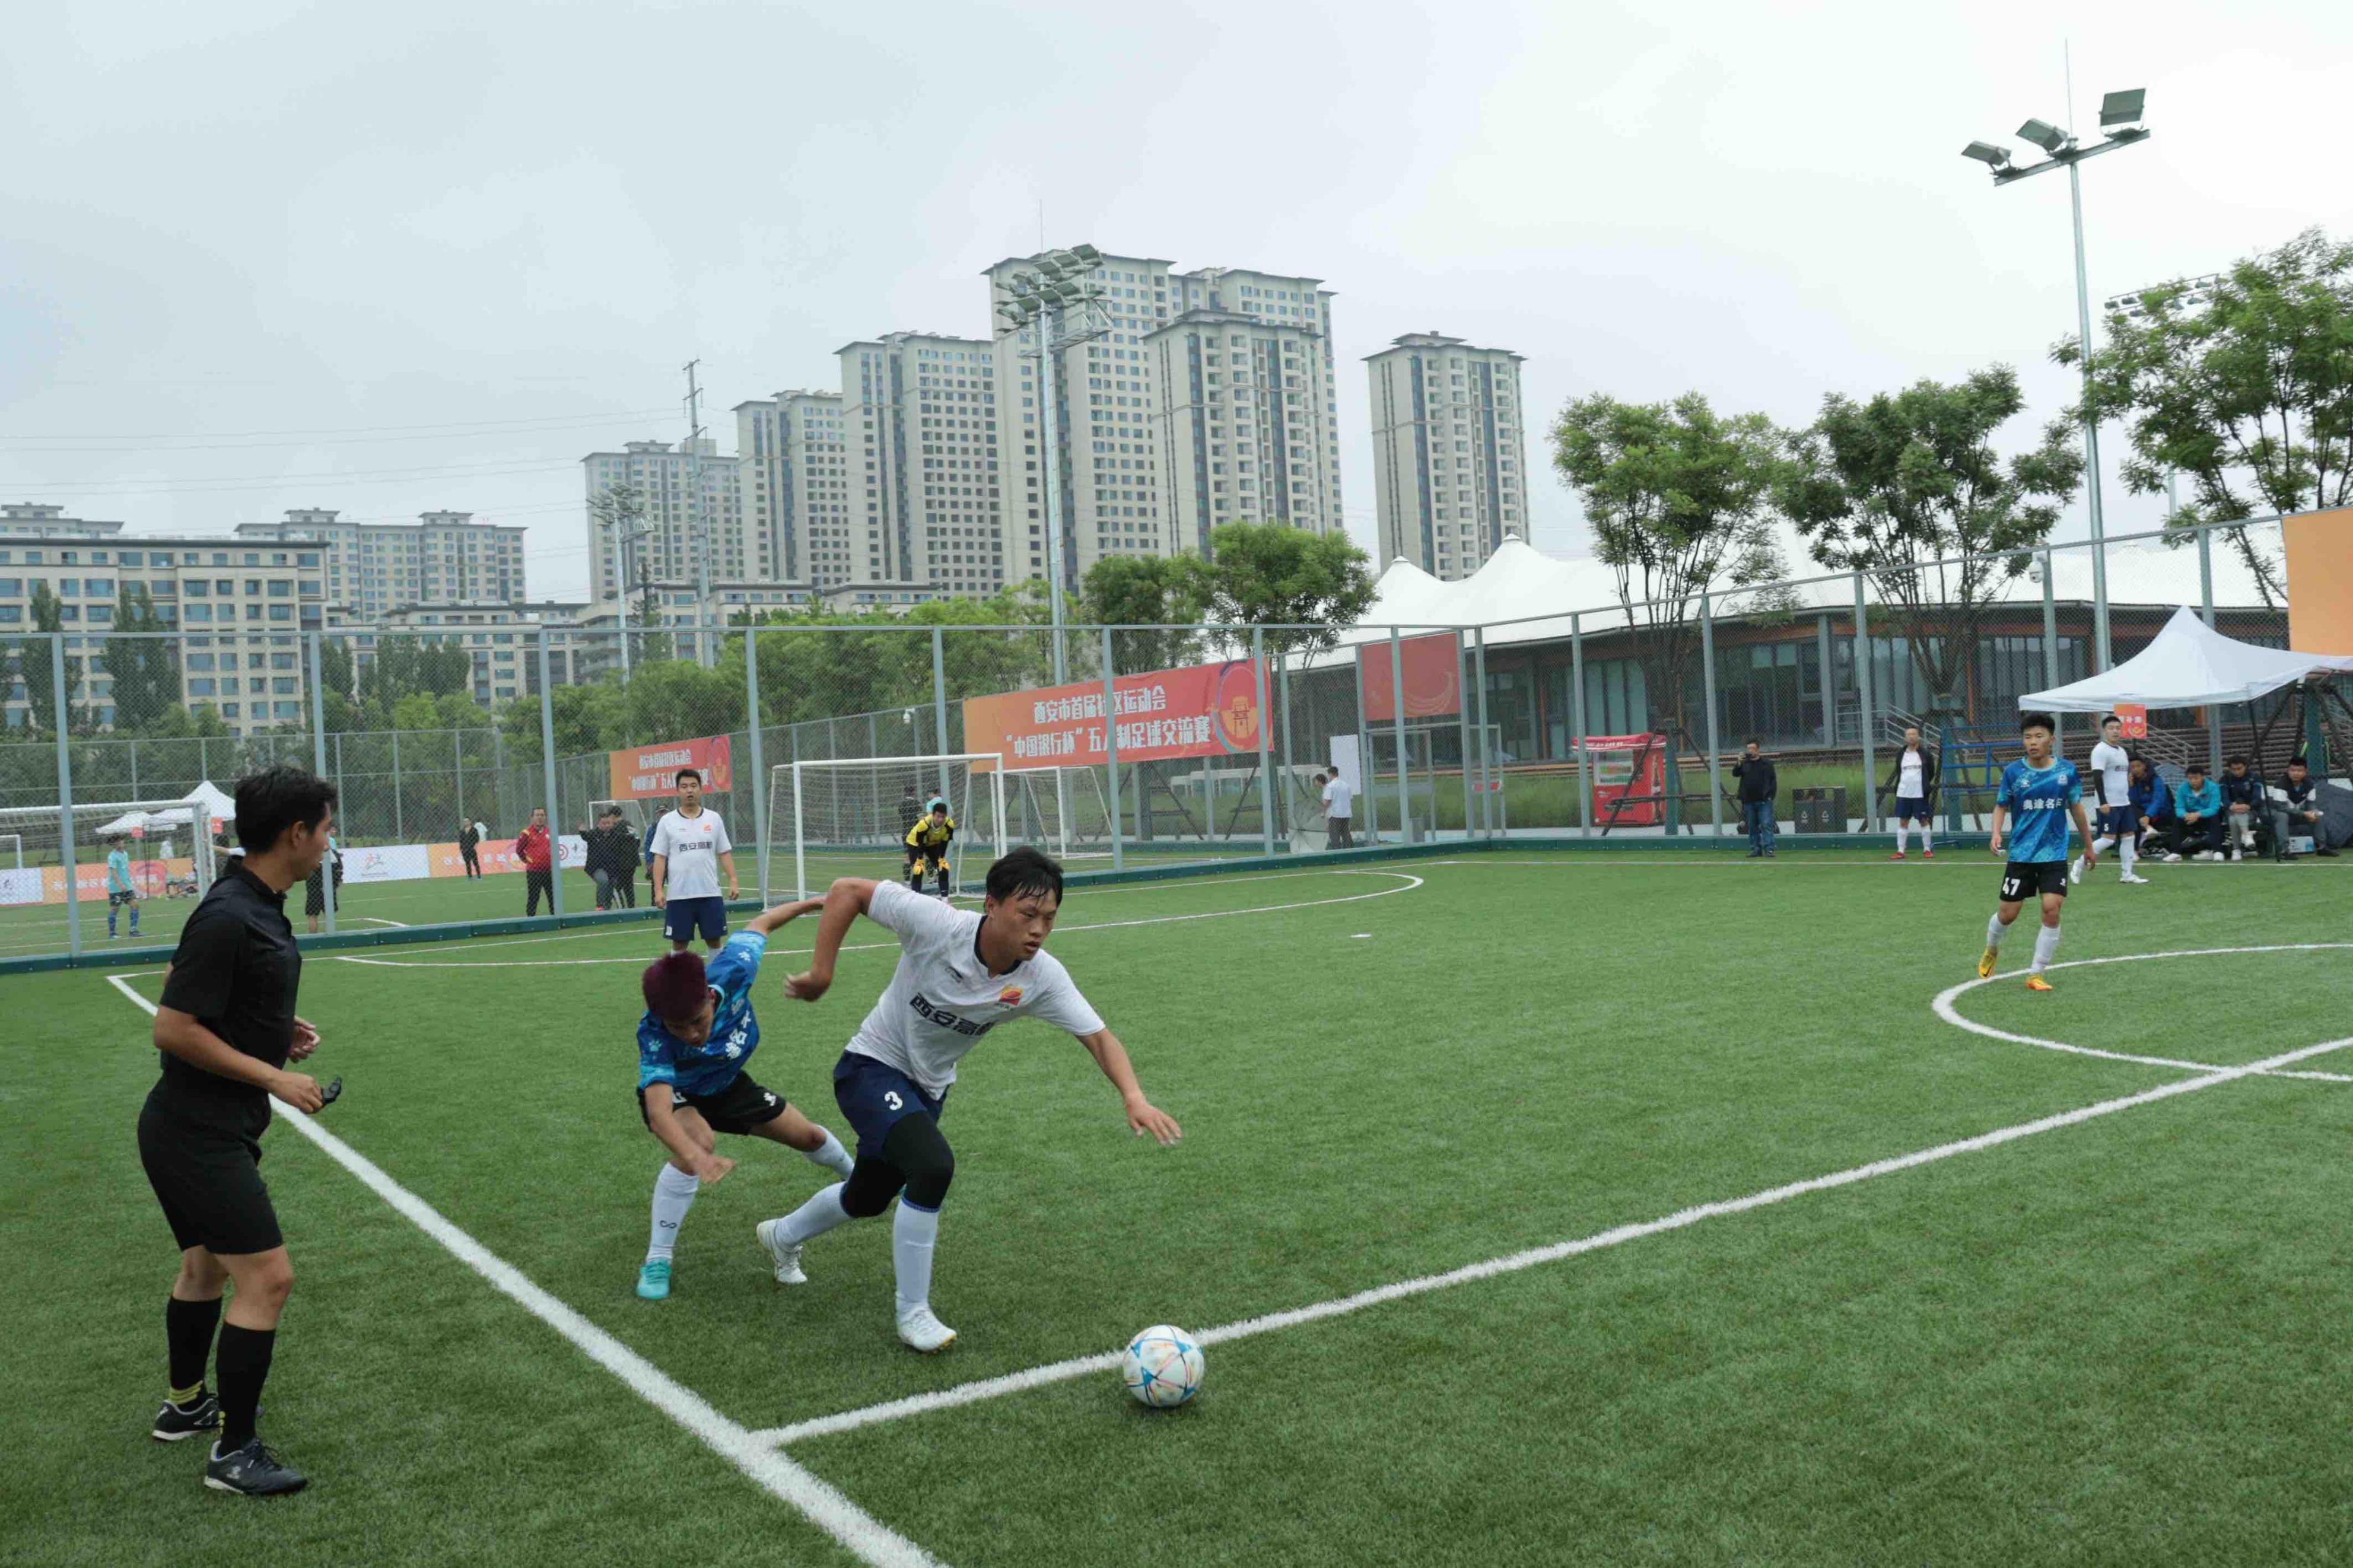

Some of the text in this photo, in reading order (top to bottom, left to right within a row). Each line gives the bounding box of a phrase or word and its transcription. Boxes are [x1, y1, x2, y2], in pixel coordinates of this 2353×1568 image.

[1034, 685, 1166, 724] 西安市首届社区运动会
[2002, 877, 2020, 896] 47
[884, 1090, 903, 1111] 3
